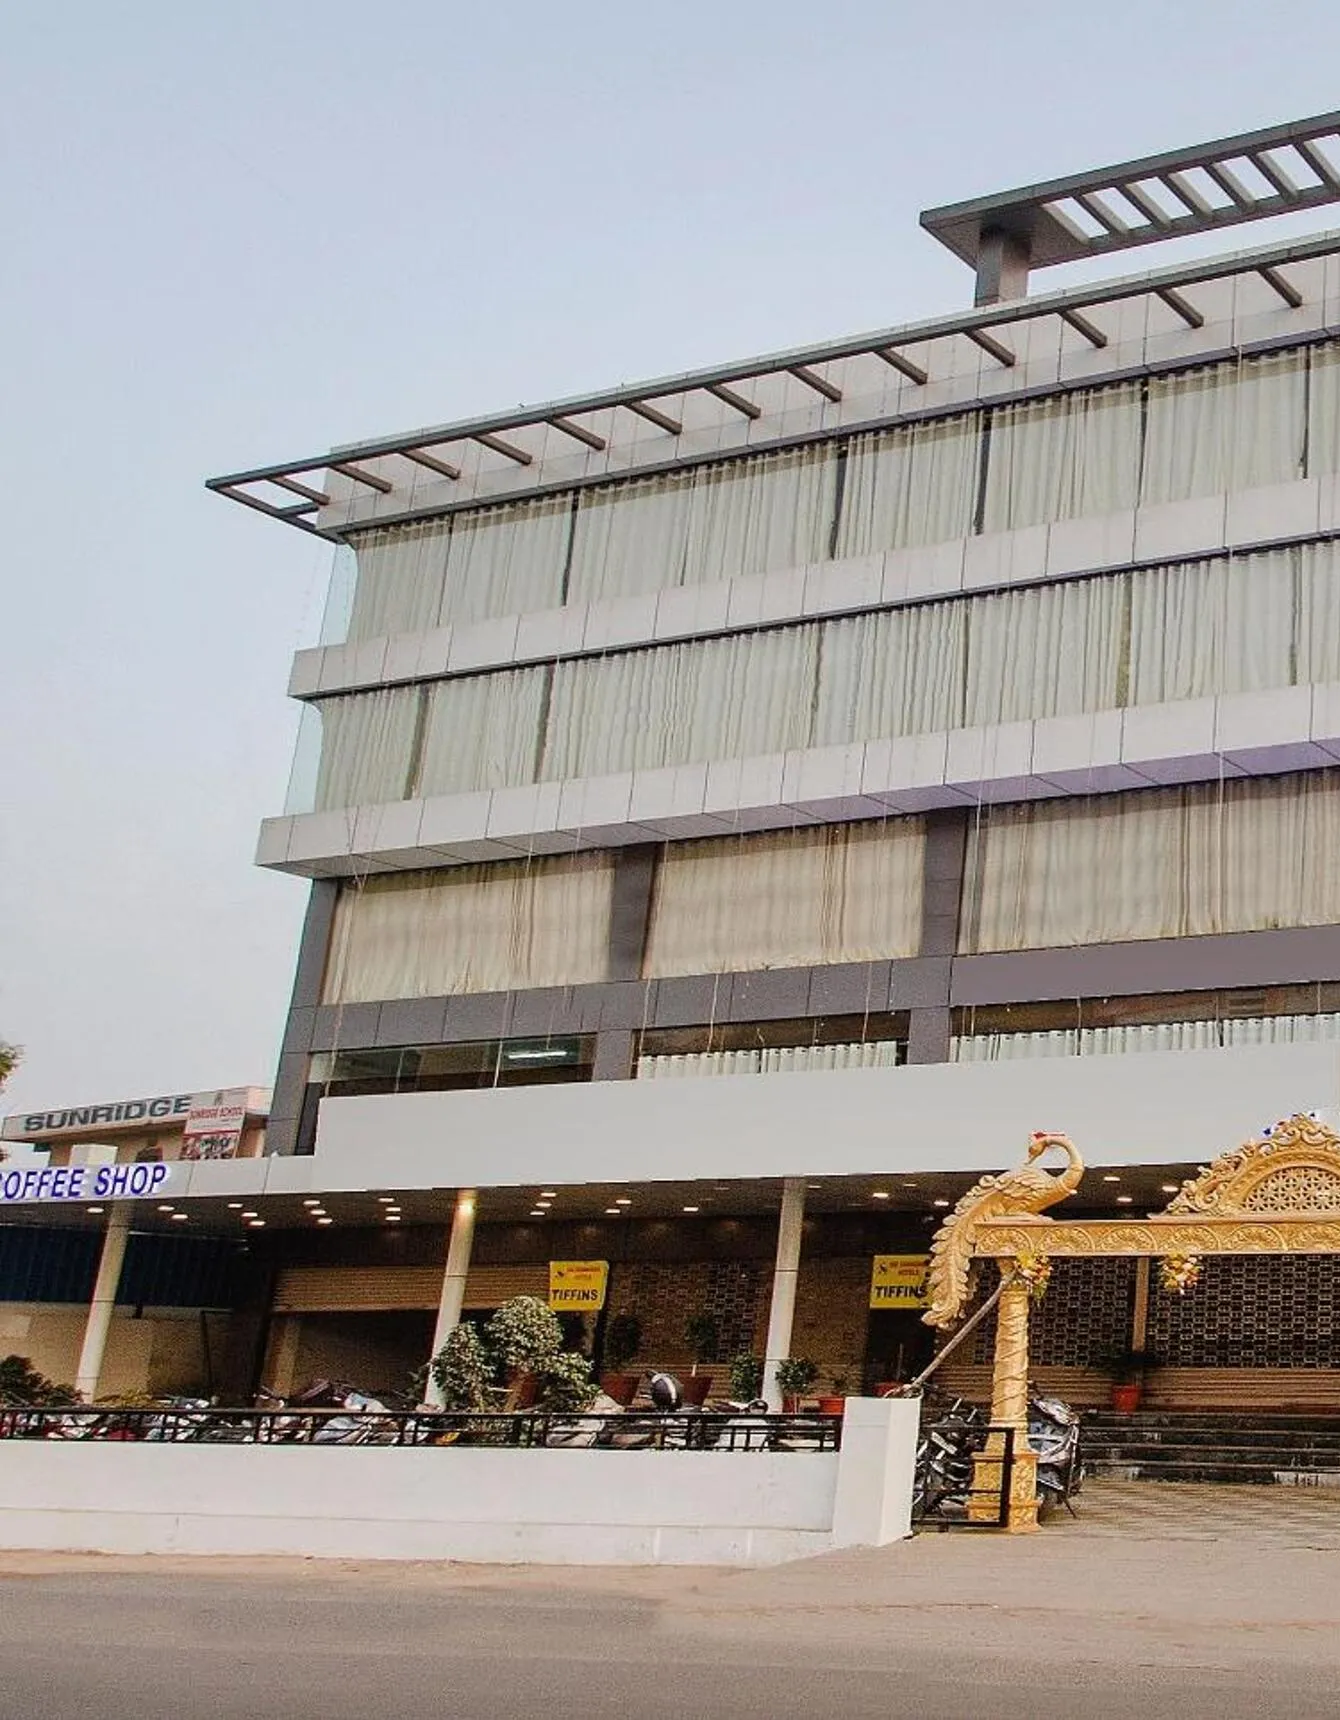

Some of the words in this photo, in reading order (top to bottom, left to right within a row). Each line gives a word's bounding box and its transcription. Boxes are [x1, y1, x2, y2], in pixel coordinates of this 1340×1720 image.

[25, 1095, 193, 1131] SUNRIDGE
[0, 1169, 85, 1199] OFFEE
[94, 1165, 168, 1195] SHOP
[551, 1289, 598, 1300] TIFFINS
[875, 1285, 927, 1298] TIFFINS
